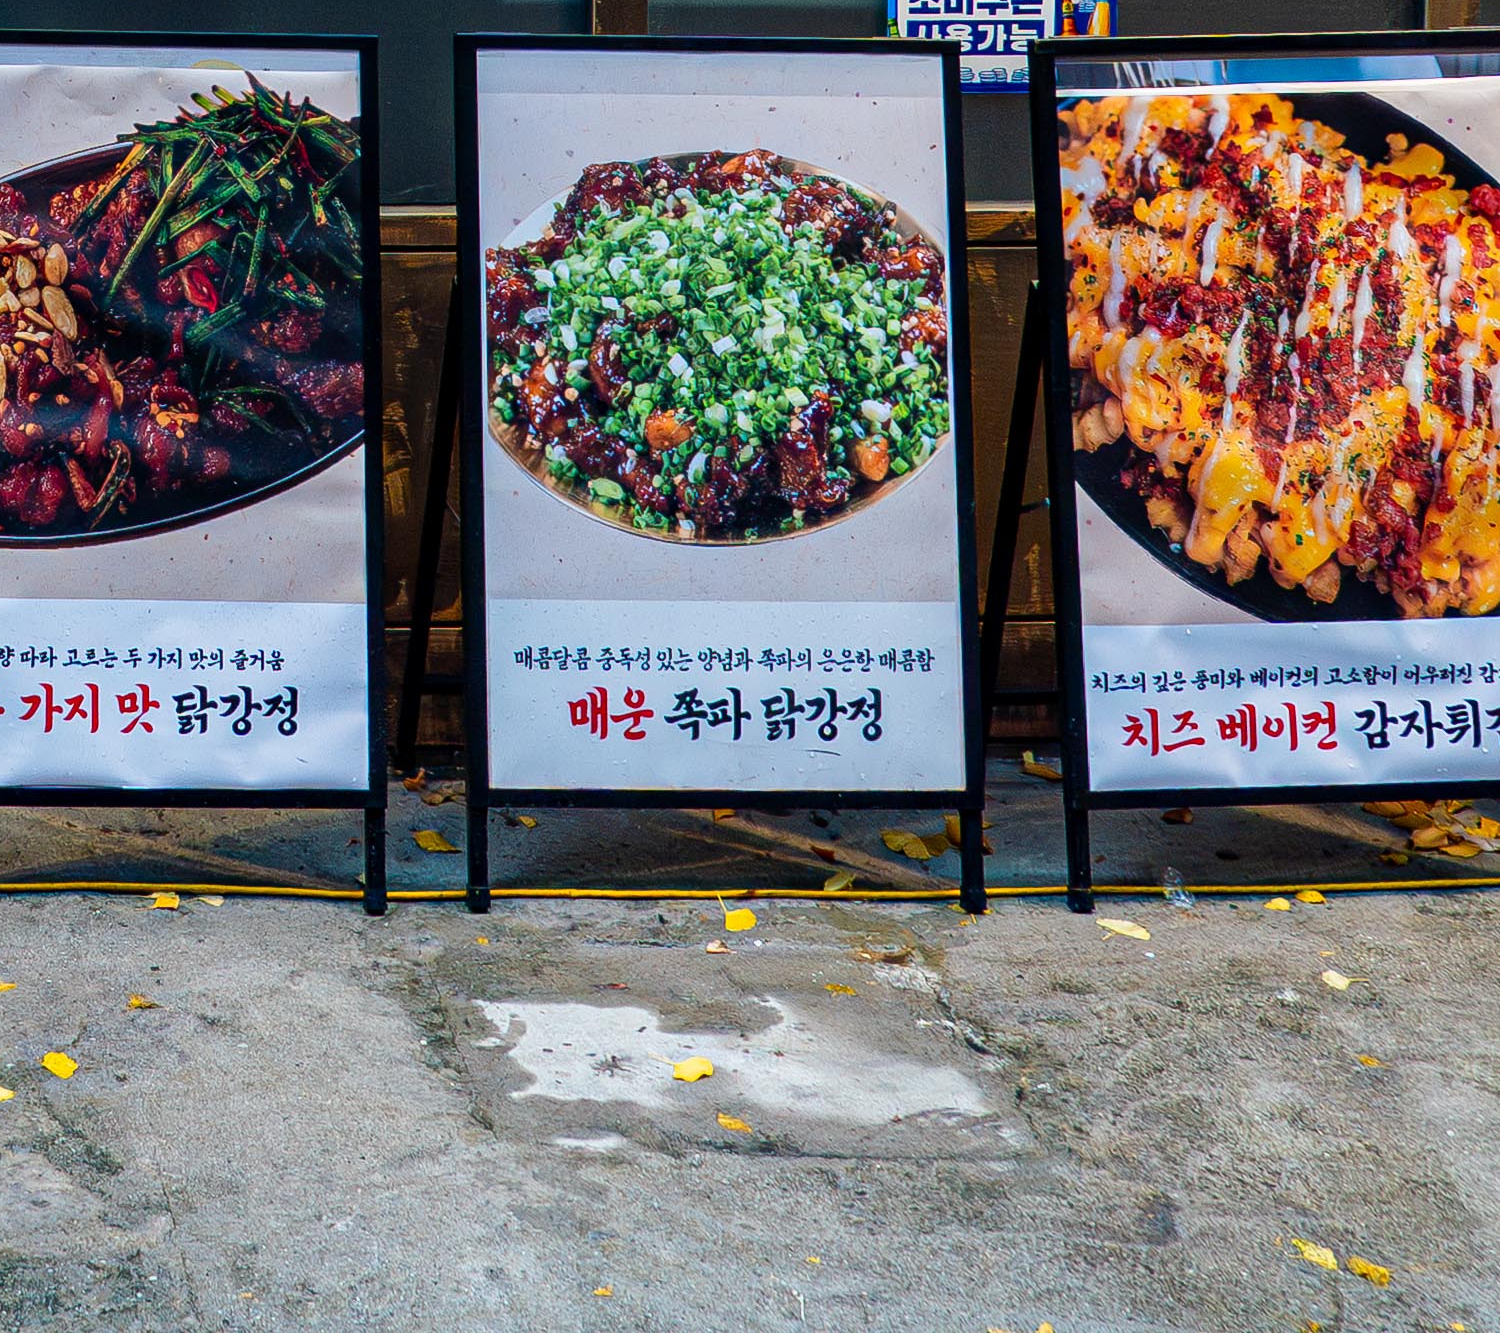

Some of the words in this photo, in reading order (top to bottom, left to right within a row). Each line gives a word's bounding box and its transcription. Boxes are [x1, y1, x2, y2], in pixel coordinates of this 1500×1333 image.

[20, 646, 57, 668] 따라
[62, 647, 119, 668] 고르는
[123, 648, 143, 668] 두
[148, 648, 184, 670] 가지
[189, 648, 224, 670] 맛의
[230, 648, 285, 672] 즐거움
[514, 645, 592, 670] 매콤달콤
[596, 646, 651, 671] 중독성
[657, 647, 690, 671] 있는
[698, 647, 753, 671] 양념과
[757, 647, 812, 671] 쪽파의
[818, 648, 875, 671] 은은한
[880, 649, 935, 674] 매콤함
[1091, 671, 1145, 693] 치즈의
[1153, 670, 1186, 692] 깊은
[1191, 669, 1245, 691] 풍미와
[1250, 667, 1319, 688] 베이컨의
[1324, 664, 1397, 688] 고소함이
[1403, 663, 1473, 685] 어우러진
[19, 682, 99, 734] 가지
[116, 685, 159, 734] 맛
[172, 685, 299, 736] 닭강정
[568, 687, 653, 740] 매운
[664, 688, 751, 740] 쪽파
[760, 688, 882, 740] 닭강정
[1121, 708, 1205, 756] 치즈
[1216, 701, 1337, 752] 베이컨
